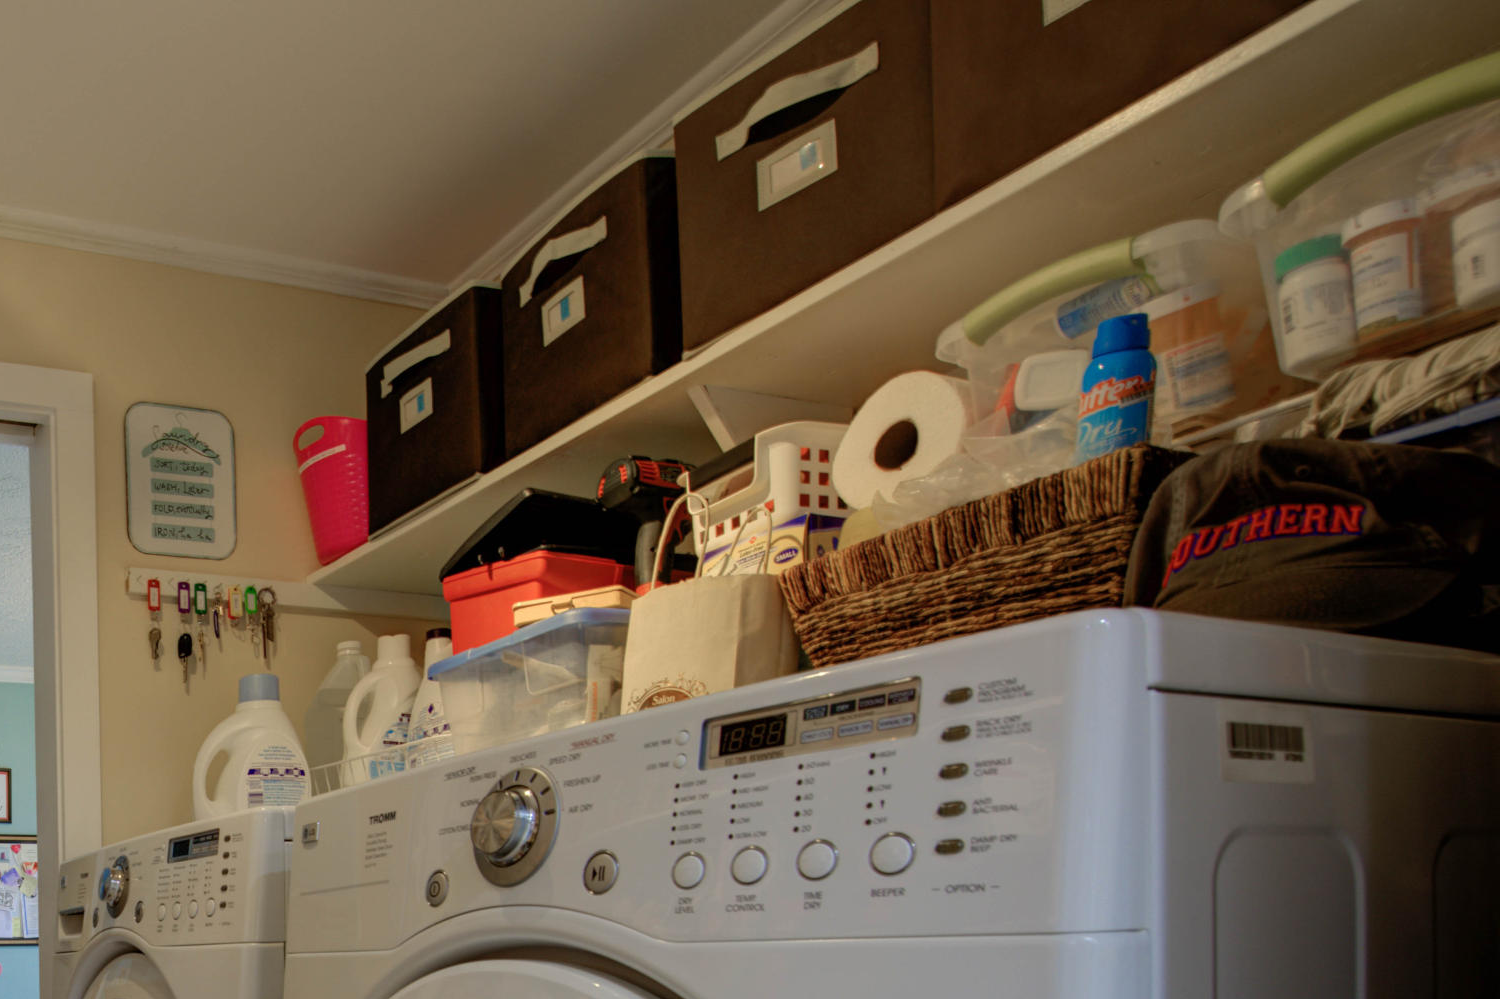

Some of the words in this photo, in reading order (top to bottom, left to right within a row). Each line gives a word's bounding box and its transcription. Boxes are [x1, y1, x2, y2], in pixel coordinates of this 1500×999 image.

[774, 548, 798, 563] SMALL
[978, 677, 1018, 690] CUSTOM
[653, 694, 676, 705] Salon
[1005, 714, 1023, 725] DRY
[974, 757, 1012, 769] WRINKLE
[974, 767, 998, 778] CARE
[802, 808, 813, 816] 30
[972, 803, 1019, 815] BACTERIAL
[369, 811, 397, 825] TROMM
[801, 825, 812, 833] 20
[970, 835, 997, 846] DAMP
[998, 833, 1018, 843] DRY
[871, 887, 906, 898] BEEPER
[945, 882, 986, 894] OPTION
[678, 896, 693, 905] DRY
[803, 891, 823, 900] TIME
[674, 905, 695, 914] LEVEL
[725, 903, 765, 913] CONTROL
[803, 901, 821, 910] DRY
